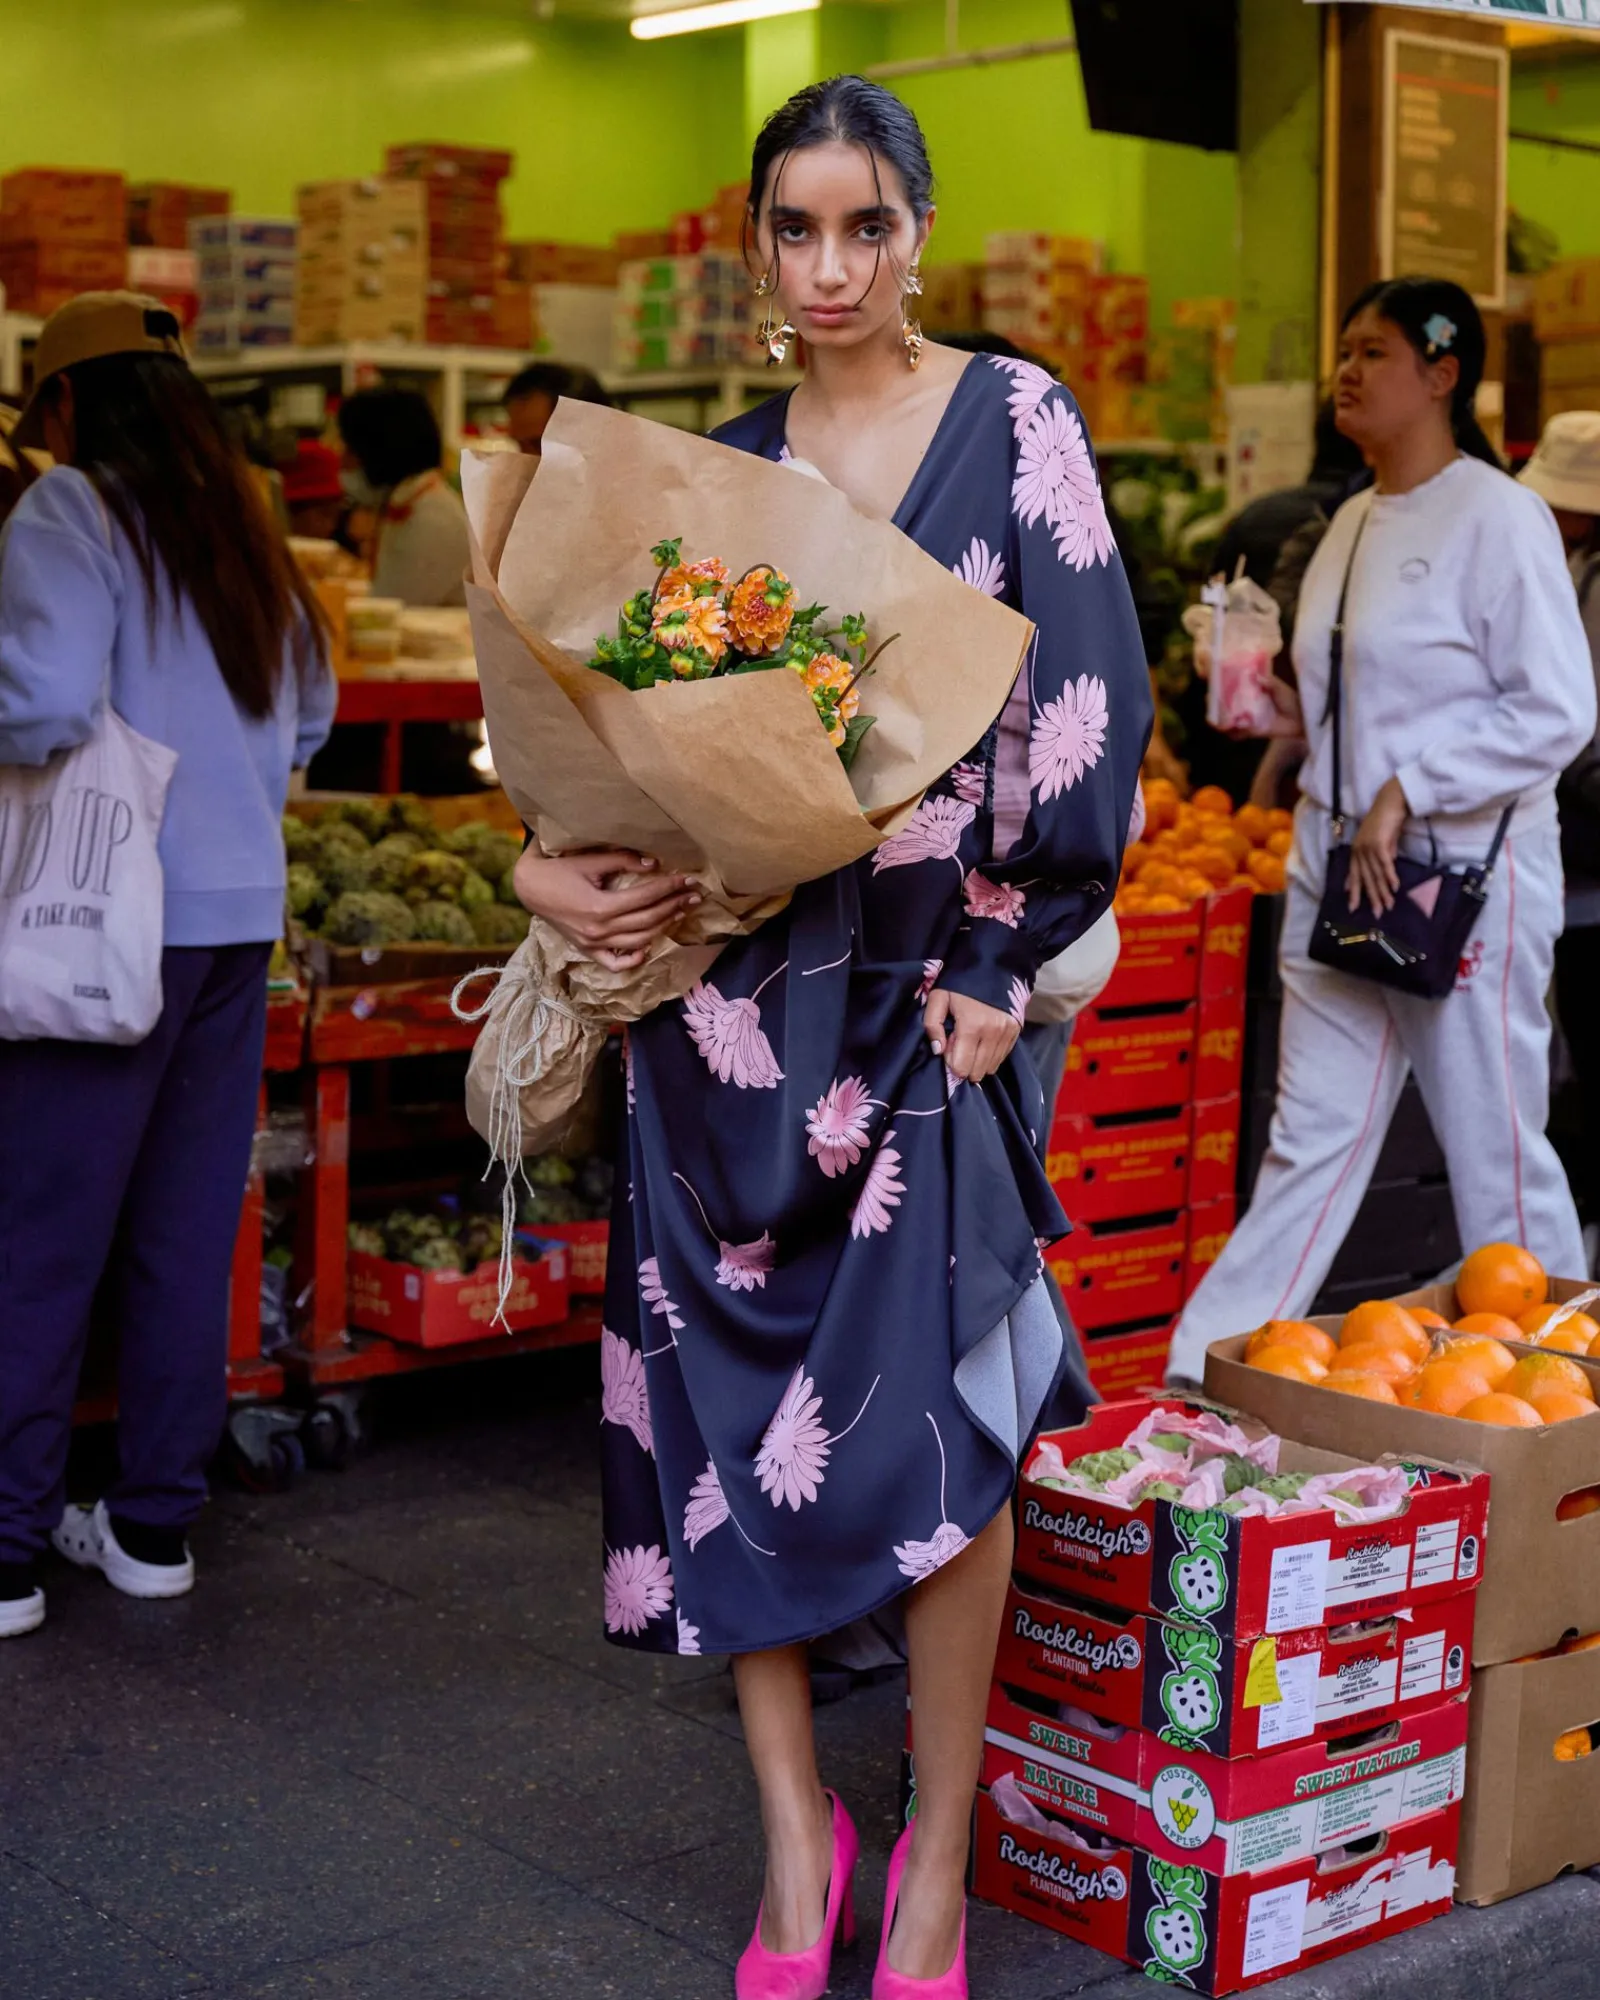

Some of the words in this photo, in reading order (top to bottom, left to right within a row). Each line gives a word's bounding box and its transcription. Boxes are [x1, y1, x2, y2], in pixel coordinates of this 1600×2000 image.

[65, 786, 133, 897] UP
[35, 903, 65, 928] TAKE
[1025, 1500, 1132, 1557] Rockleigh
[1054, 1540, 1099, 1564] PLANTATION
[1345, 1541, 1392, 1561] Rockleigh
[1015, 1609, 1121, 1670] Rockleigh
[1042, 1650, 1089, 1676] PLANTATION
[1337, 1655, 1380, 1679] Rockleigh
[1029, 1721, 1092, 1760] SWEET
[1023, 1760, 1099, 1808] NATURE
[1161, 1769, 1208, 1798] CUSTARD
[1295, 1767, 1353, 1797] SWEET
[1355, 1741, 1421, 1779] NATURE
[1162, 1823, 1202, 1847] APPLES
[1000, 1835, 1105, 1900] Rockleigh
[1029, 1874, 1076, 1904] PLANTATION
